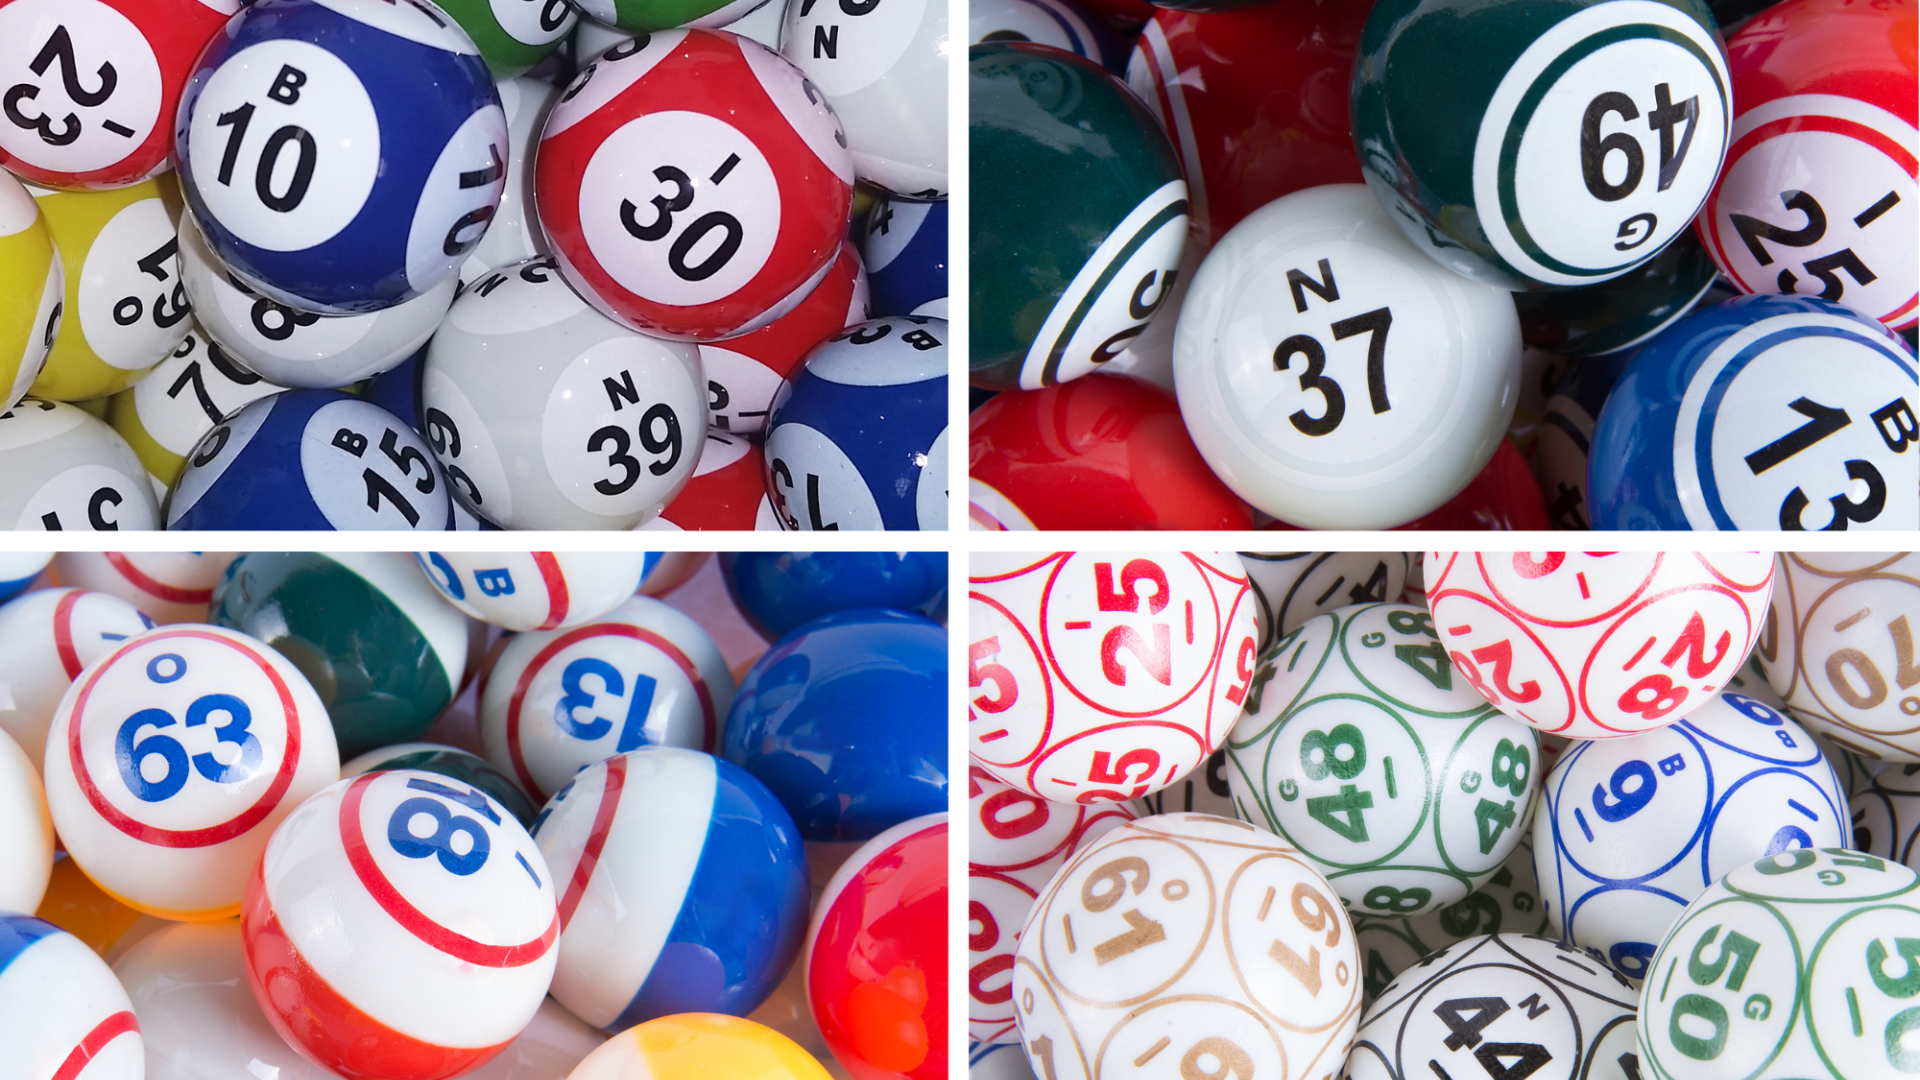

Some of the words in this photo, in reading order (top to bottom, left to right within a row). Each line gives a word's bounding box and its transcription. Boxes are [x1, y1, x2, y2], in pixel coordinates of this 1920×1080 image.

[813, 25, 839, 59] N
[3, 25, 118, 146] 23
[267, 63, 307, 105] B
[216, 101, 317, 213] 10
[1580, 82, 1700, 202] 49
[619, 165, 744, 282] 30
[1614, 212, 1658, 252] G
[1729, 189, 1879, 302] 25
[1286, 258, 1341, 314] N
[901, 328, 943, 351] B
[1273, 306, 1393, 437] 37
[602, 370, 640, 412] N
[1869, 396, 1918, 453] B
[331, 427, 368, 459] B
[362, 427, 436, 529] 15
[587, 402, 683, 496] 39
[1743, 396, 1888, 531] 13
[473, 568, 516, 597] B
[1094, 558, 1172, 686] 25
[146, 653, 187, 684] O
[1361, 631, 1386, 649] G
[1388, 610, 1453, 691] 48
[1618, 611, 1732, 720] 28
[1826, 614, 1918, 709] 70
[553, 657, 657, 753] 13
[1775, 730, 1798, 748] B
[115, 693, 263, 802] 63
[1300, 723, 1374, 843] 48
[1460, 769, 1481, 793] G
[1657, 753, 1686, 777] B
[387, 778, 502, 876] 18
[1279, 778, 1299, 802] G
[1474, 738, 1531, 855] 48
[1592, 760, 1657, 822] 9
[1081, 857, 1167, 966] 61
[1816, 870, 1846, 885] G
[1268, 882, 1341, 998] 61
[1517, 993, 1551, 1020] N
[1669, 924, 1762, 1061] 50
[1743, 993, 1773, 1021] G
[1433, 997, 1554, 1080] 44
